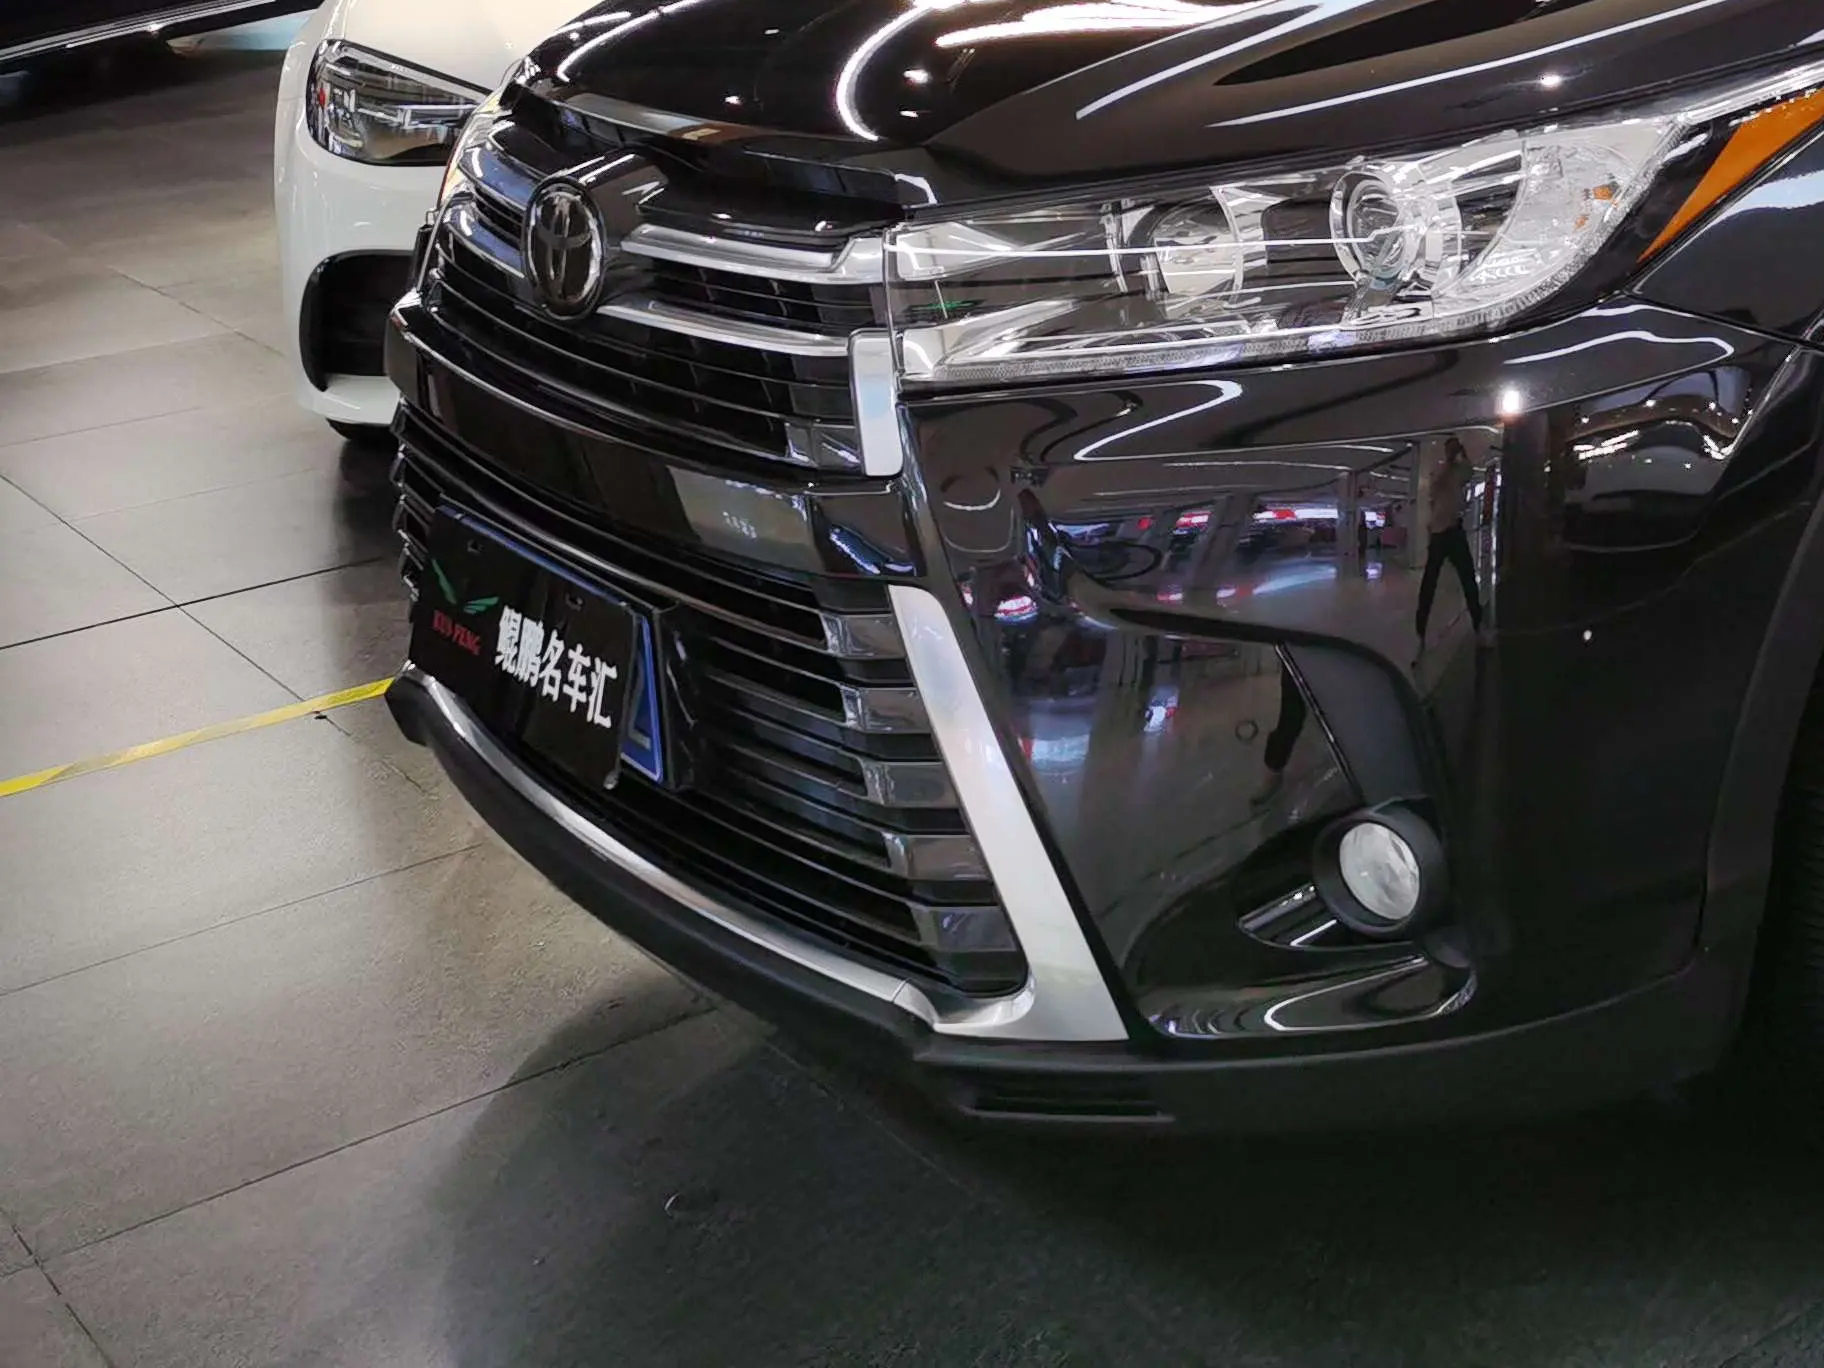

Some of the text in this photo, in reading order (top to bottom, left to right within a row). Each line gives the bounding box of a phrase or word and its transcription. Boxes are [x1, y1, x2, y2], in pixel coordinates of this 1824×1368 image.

[494, 604, 619, 729] 鲲鹏名车汇
